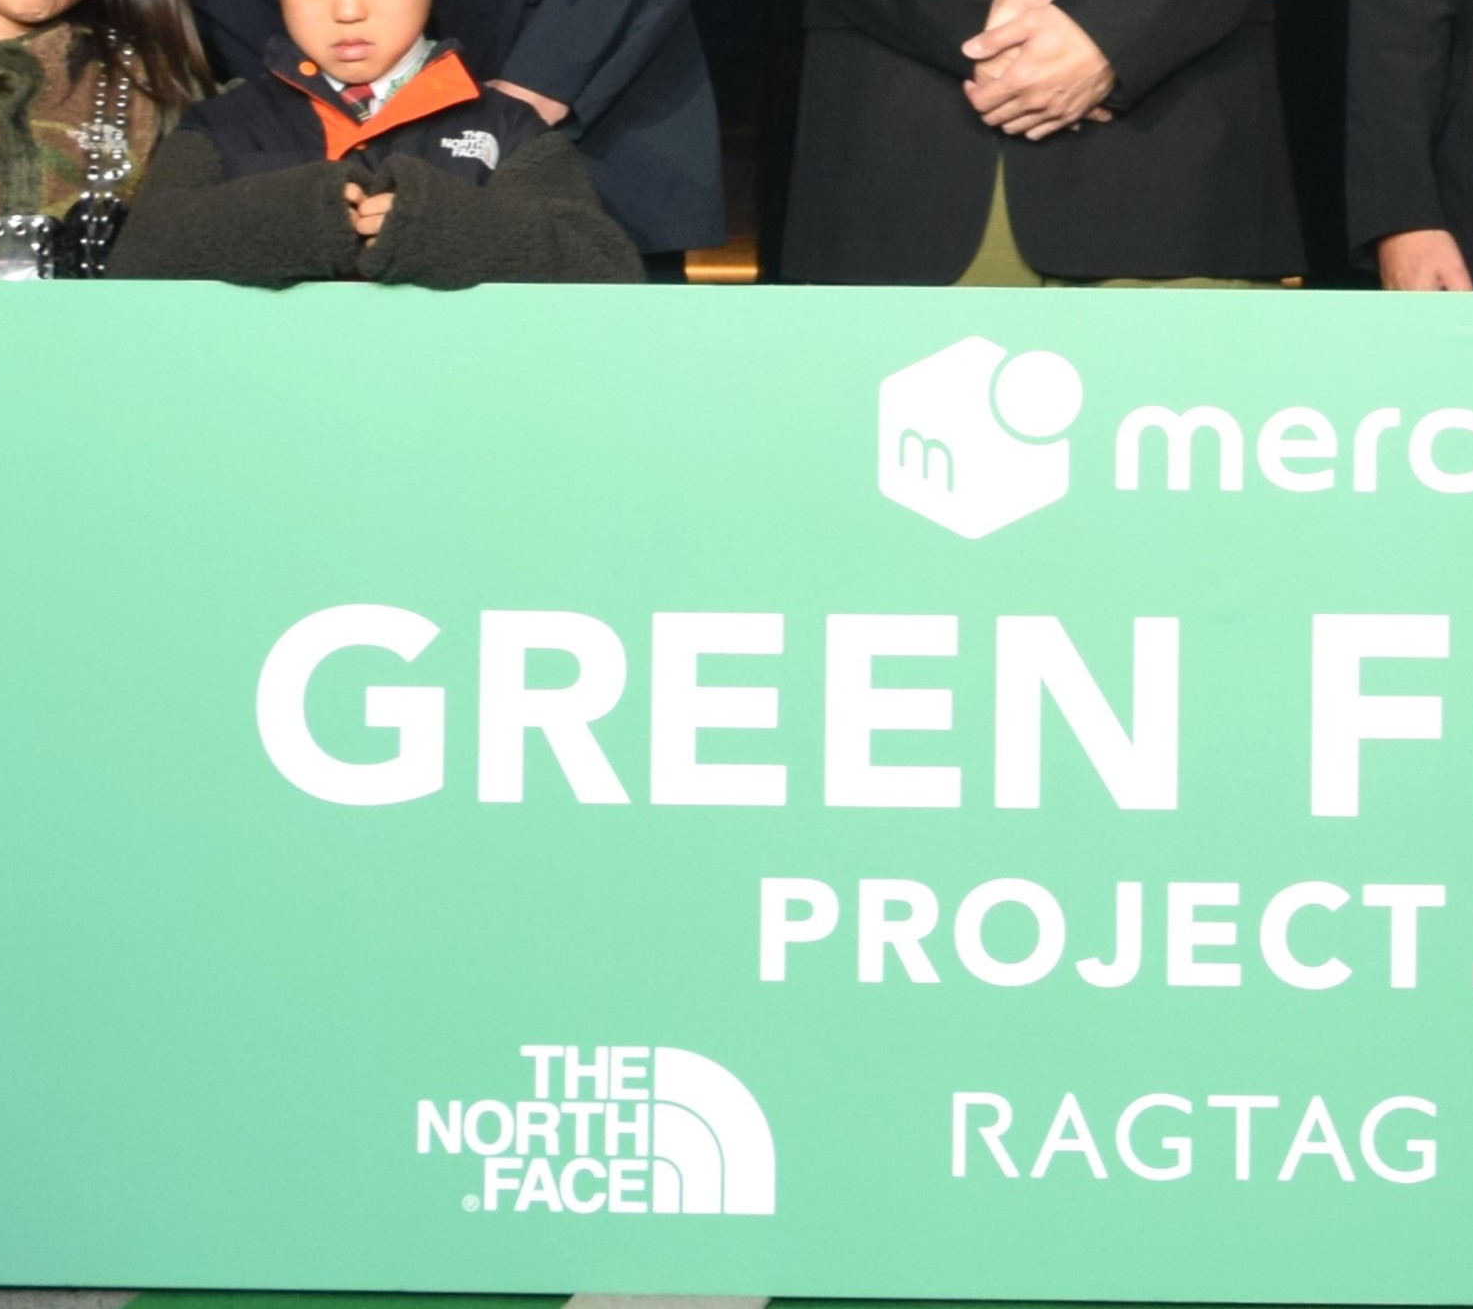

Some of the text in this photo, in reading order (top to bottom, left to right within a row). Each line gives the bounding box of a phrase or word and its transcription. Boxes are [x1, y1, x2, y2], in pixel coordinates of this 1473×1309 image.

[257, 604, 1180, 810] GREEN
[760, 878, 1446, 990] PROJECT
[520, 1044, 650, 1100] THE
[417, 1099, 650, 1156] NORTH
[952, 1092, 1437, 1184] RAGTAG
[483, 1156, 649, 1214] FACE
